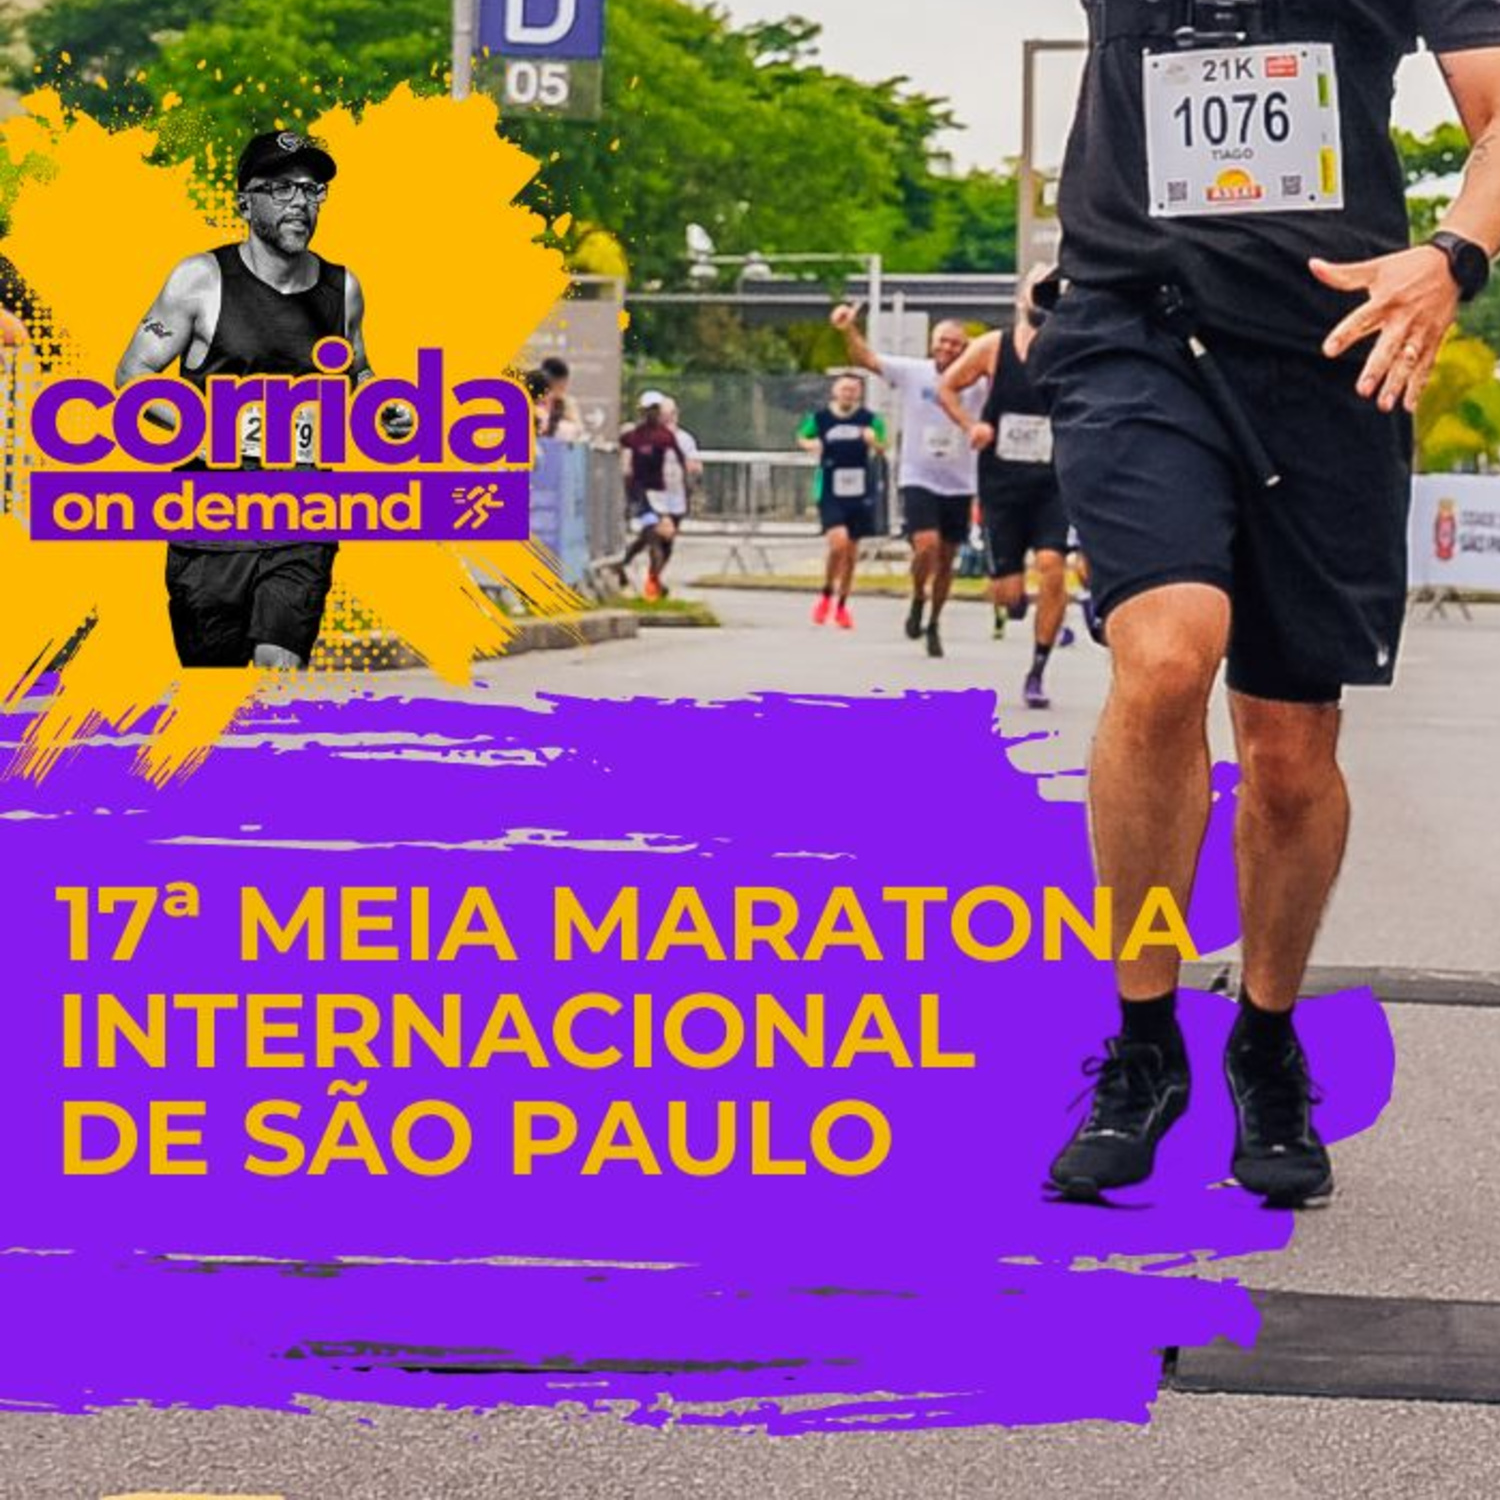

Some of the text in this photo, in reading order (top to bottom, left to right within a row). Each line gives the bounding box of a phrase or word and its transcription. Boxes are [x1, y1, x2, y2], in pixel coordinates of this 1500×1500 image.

[505, 63, 571, 106] 05
[1203, 56, 1255, 82] 21K
[1174, 91, 1290, 147] 1076
[1211, 148, 1255, 161] TIAGO
